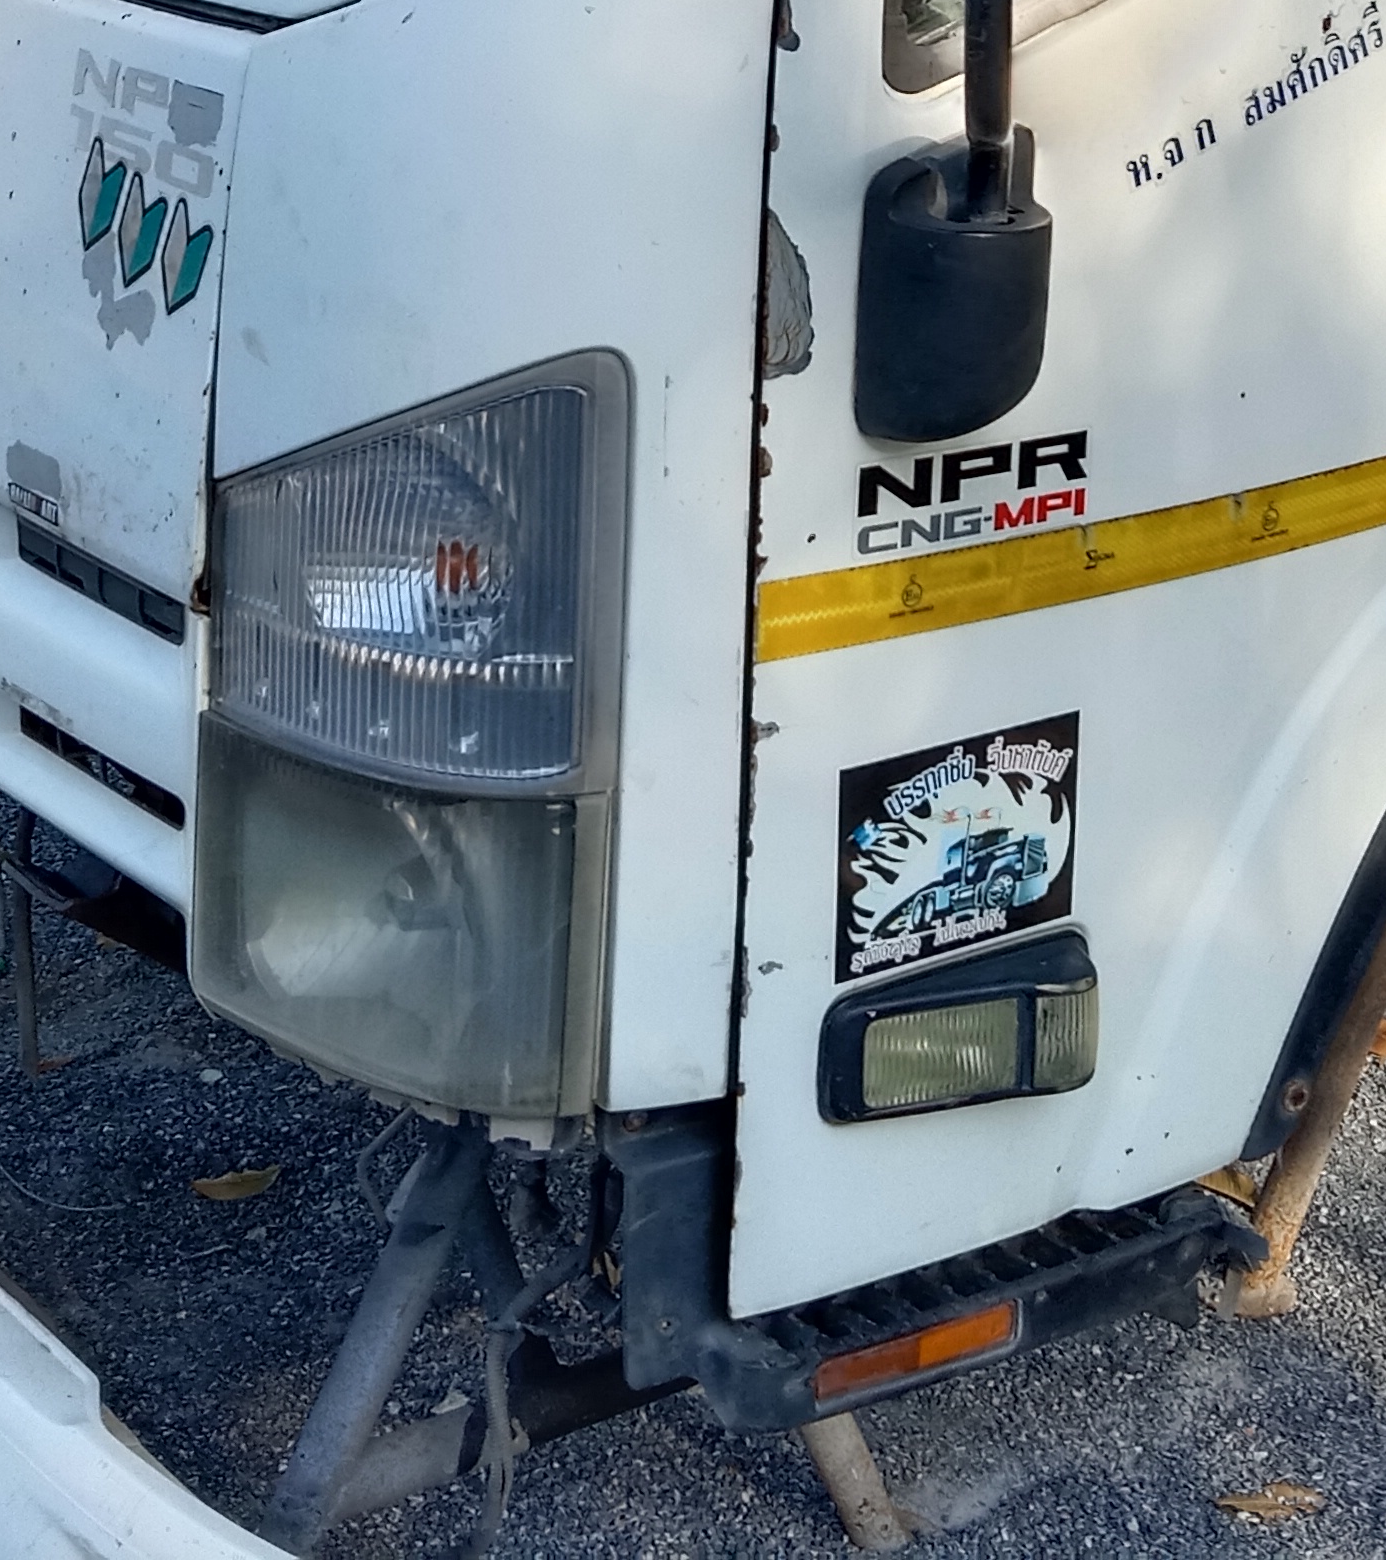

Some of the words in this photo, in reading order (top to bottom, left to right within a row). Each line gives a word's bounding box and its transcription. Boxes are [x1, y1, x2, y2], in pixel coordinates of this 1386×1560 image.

[70, 104, 215, 199] 150
[857, 430, 1088, 518] NPR
[857, 488, 1086, 555] CNG-MPI
